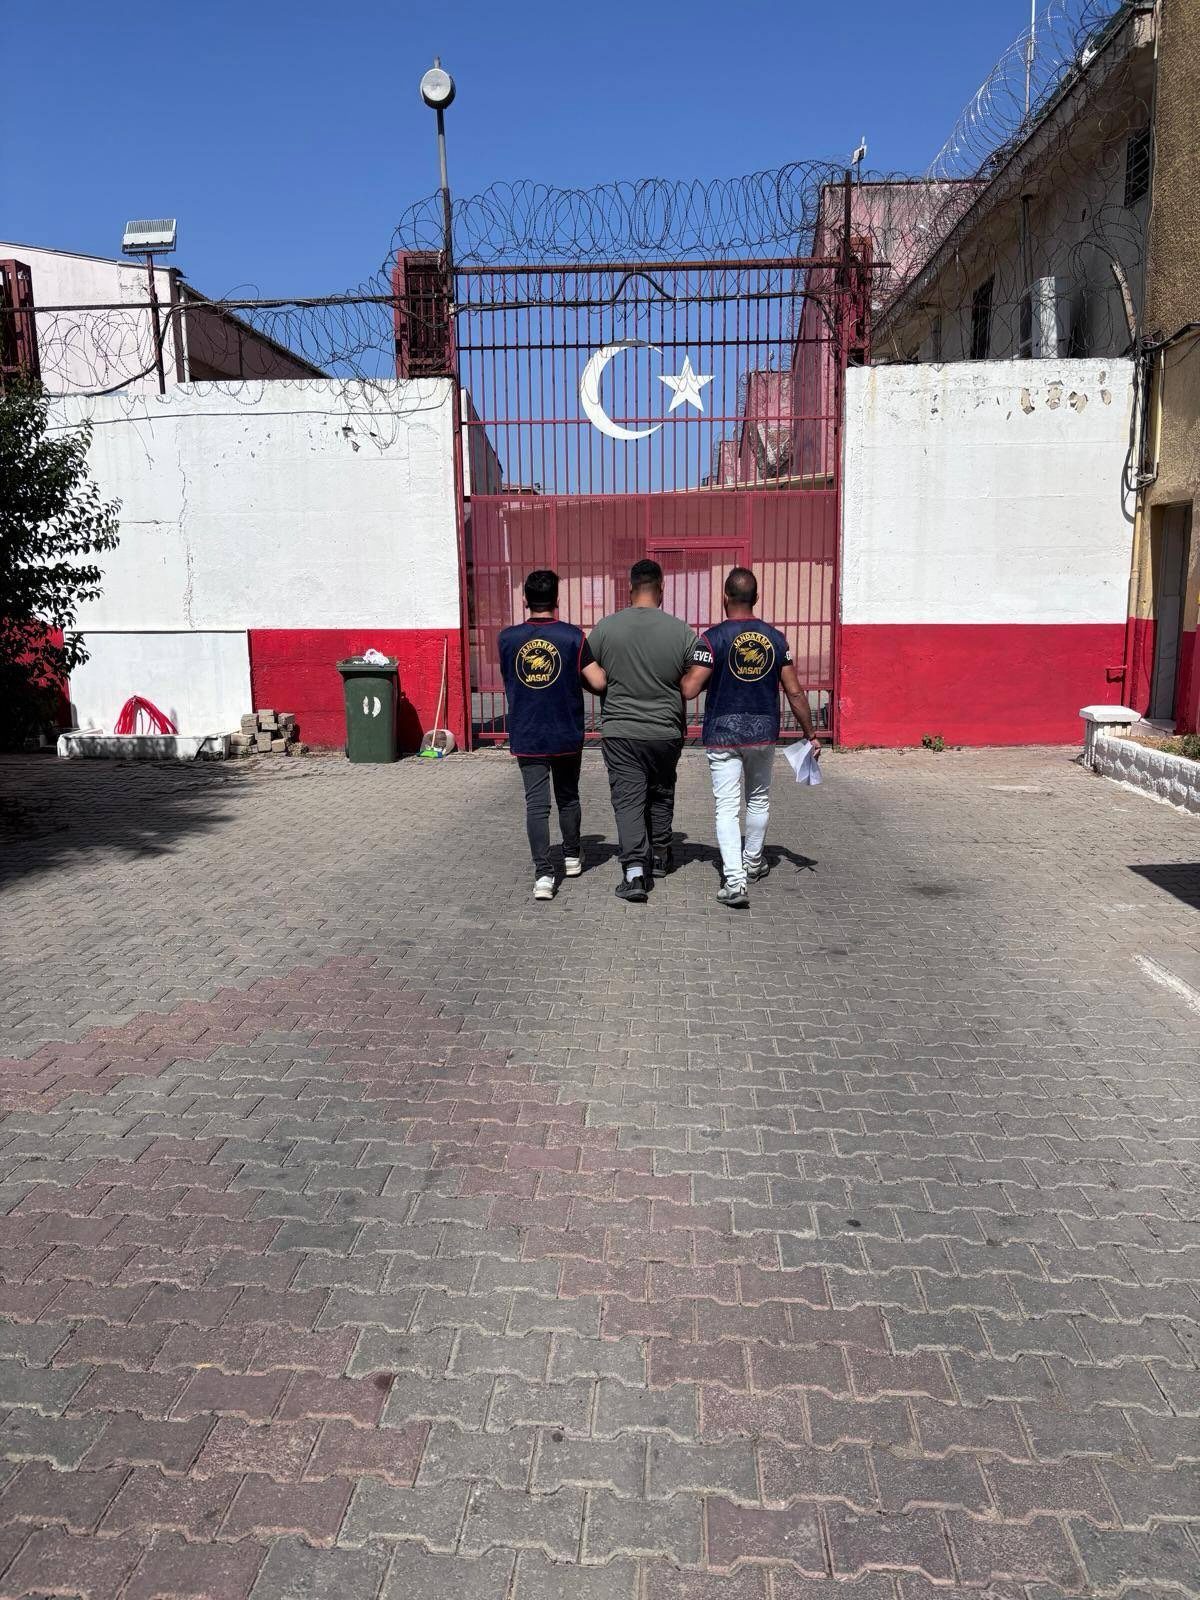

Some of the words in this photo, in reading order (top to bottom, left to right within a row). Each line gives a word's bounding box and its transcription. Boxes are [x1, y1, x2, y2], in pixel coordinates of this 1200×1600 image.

[733, 633, 771, 650] JANDARMA
[520, 641, 558, 658] JANDARMA
[737, 666, 762, 675] JASAT
[525, 674, 551, 683] JASAT
